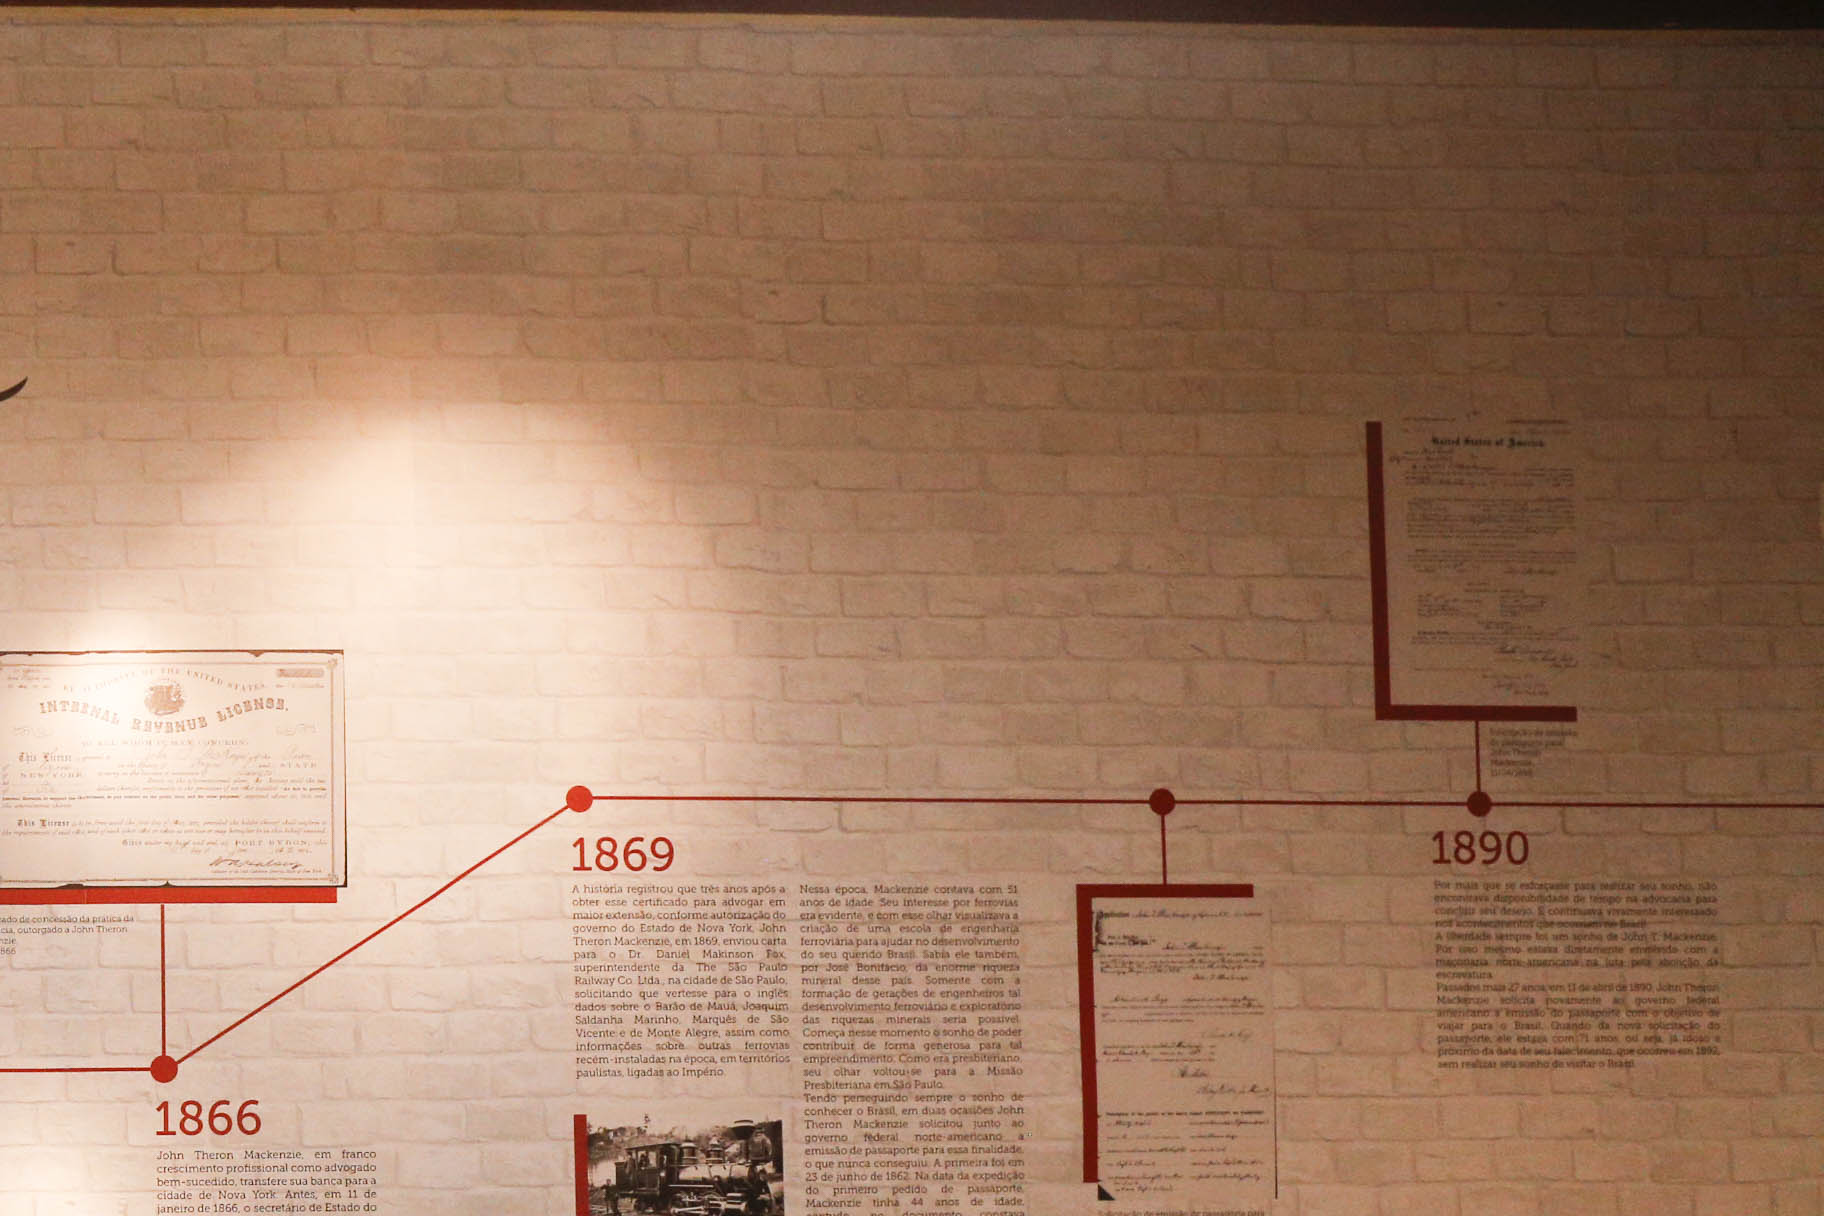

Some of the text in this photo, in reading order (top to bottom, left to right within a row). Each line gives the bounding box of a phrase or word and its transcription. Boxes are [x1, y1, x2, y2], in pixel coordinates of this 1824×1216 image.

[131, 716, 208, 733] REVENUE
[572, 836, 675, 872] 1869
[1431, 830, 1530, 866] 1890
[573, 936, 612, 946] Theron
[614, 936, 673, 947] Mackenzie,
[674, 938, 692, 946] em
[722, 936, 759, 946] enviou
[761, 936, 787, 946] carta
[155, 1099, 262, 1136] 1866
[156, 1150, 185, 1160] John
[194, 1150, 234, 1160] Theron
[342, 1149, 377, 1159] franco
[156, 1163, 224, 1173] crescimento
[226, 1163, 288, 1175] profissional
[324, 1162, 377, 1175] advogado
[805, 1172, 817, 1181] 23
[821, 1171, 834, 1181] de
[836, 1171, 866, 1184] junho
[870, 1171, 883, 1181] de
[915, 1171, 929, 1181] Na
[931, 1171, 954, 1181] data
[957, 1171, 970, 1181] da
[972, 1171, 1025, 1183] expedição
